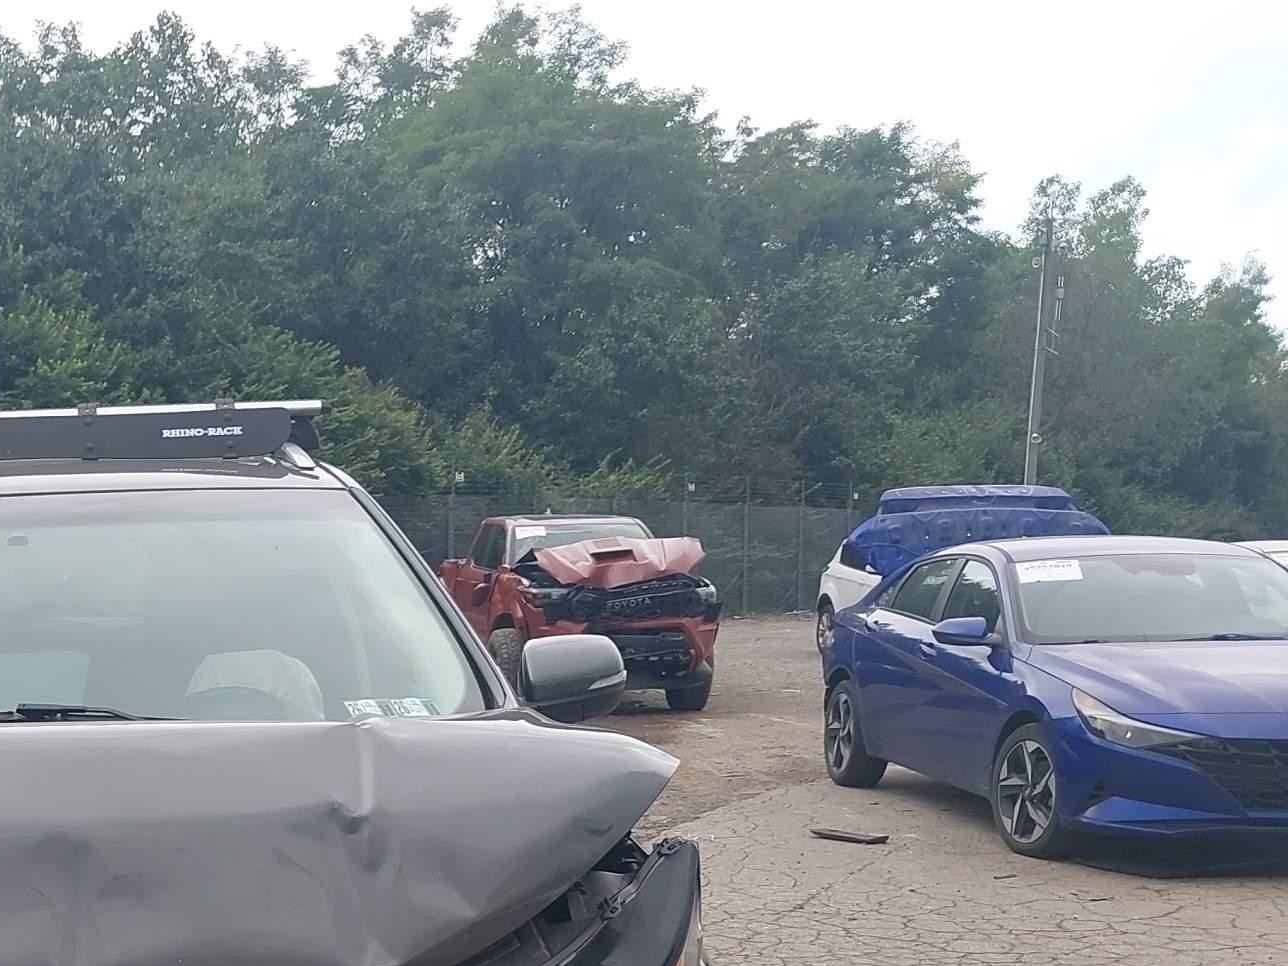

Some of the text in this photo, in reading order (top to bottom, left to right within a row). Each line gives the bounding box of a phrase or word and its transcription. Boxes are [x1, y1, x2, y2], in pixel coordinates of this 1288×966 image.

[162, 426, 243, 438] RHINO-RACK
[606, 597, 652, 609] TOYOTA
[393, 700, 411, 715] 26
